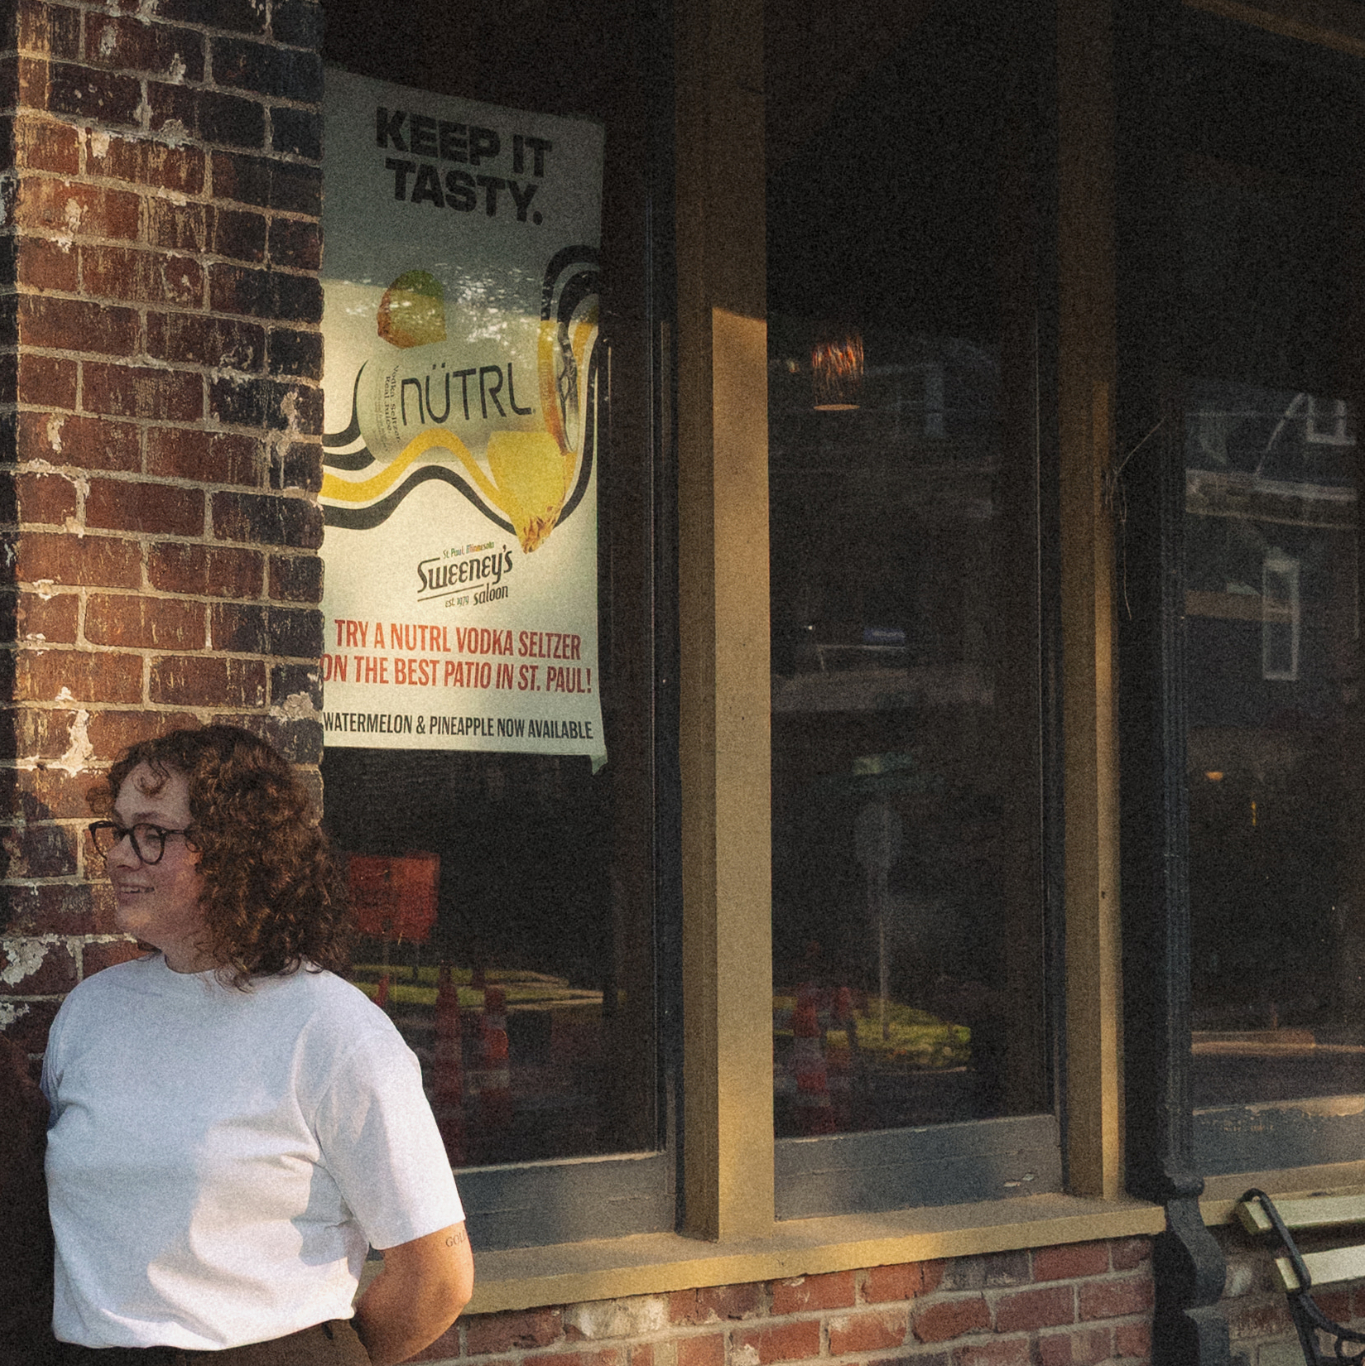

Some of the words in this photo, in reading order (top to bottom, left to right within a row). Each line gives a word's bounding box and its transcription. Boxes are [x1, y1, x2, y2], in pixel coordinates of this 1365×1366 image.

[376, 106, 501, 166] KEEP
[512, 135, 553, 178] IT
[385, 158, 544, 226] TASTY.
[417, 544, 513, 593] Sweeney's
[473, 582, 509, 606] saloon
[334, 619, 369, 648] TRY
[374, 622, 386, 649] A
[390, 623, 452, 653] NUTRL
[456, 627, 514, 657] VODKA
[518, 630, 582, 661] SELTZER
[319, 653, 348, 683] ON
[354, 655, 389, 685] THE
[394, 658, 440, 687] BEST
[444, 660, 492, 689] PATIO
[496, 663, 514, 690] IN
[517, 664, 541, 692] ST.
[546, 666, 592, 694] PAUL!
[322, 711, 413, 734] WATERMELON
[416, 715, 426, 735] &
[430, 716, 495, 736] PINEAPPLE
[497, 718, 526, 738] NOW
[528, 719, 594, 740] AVAILABLE
